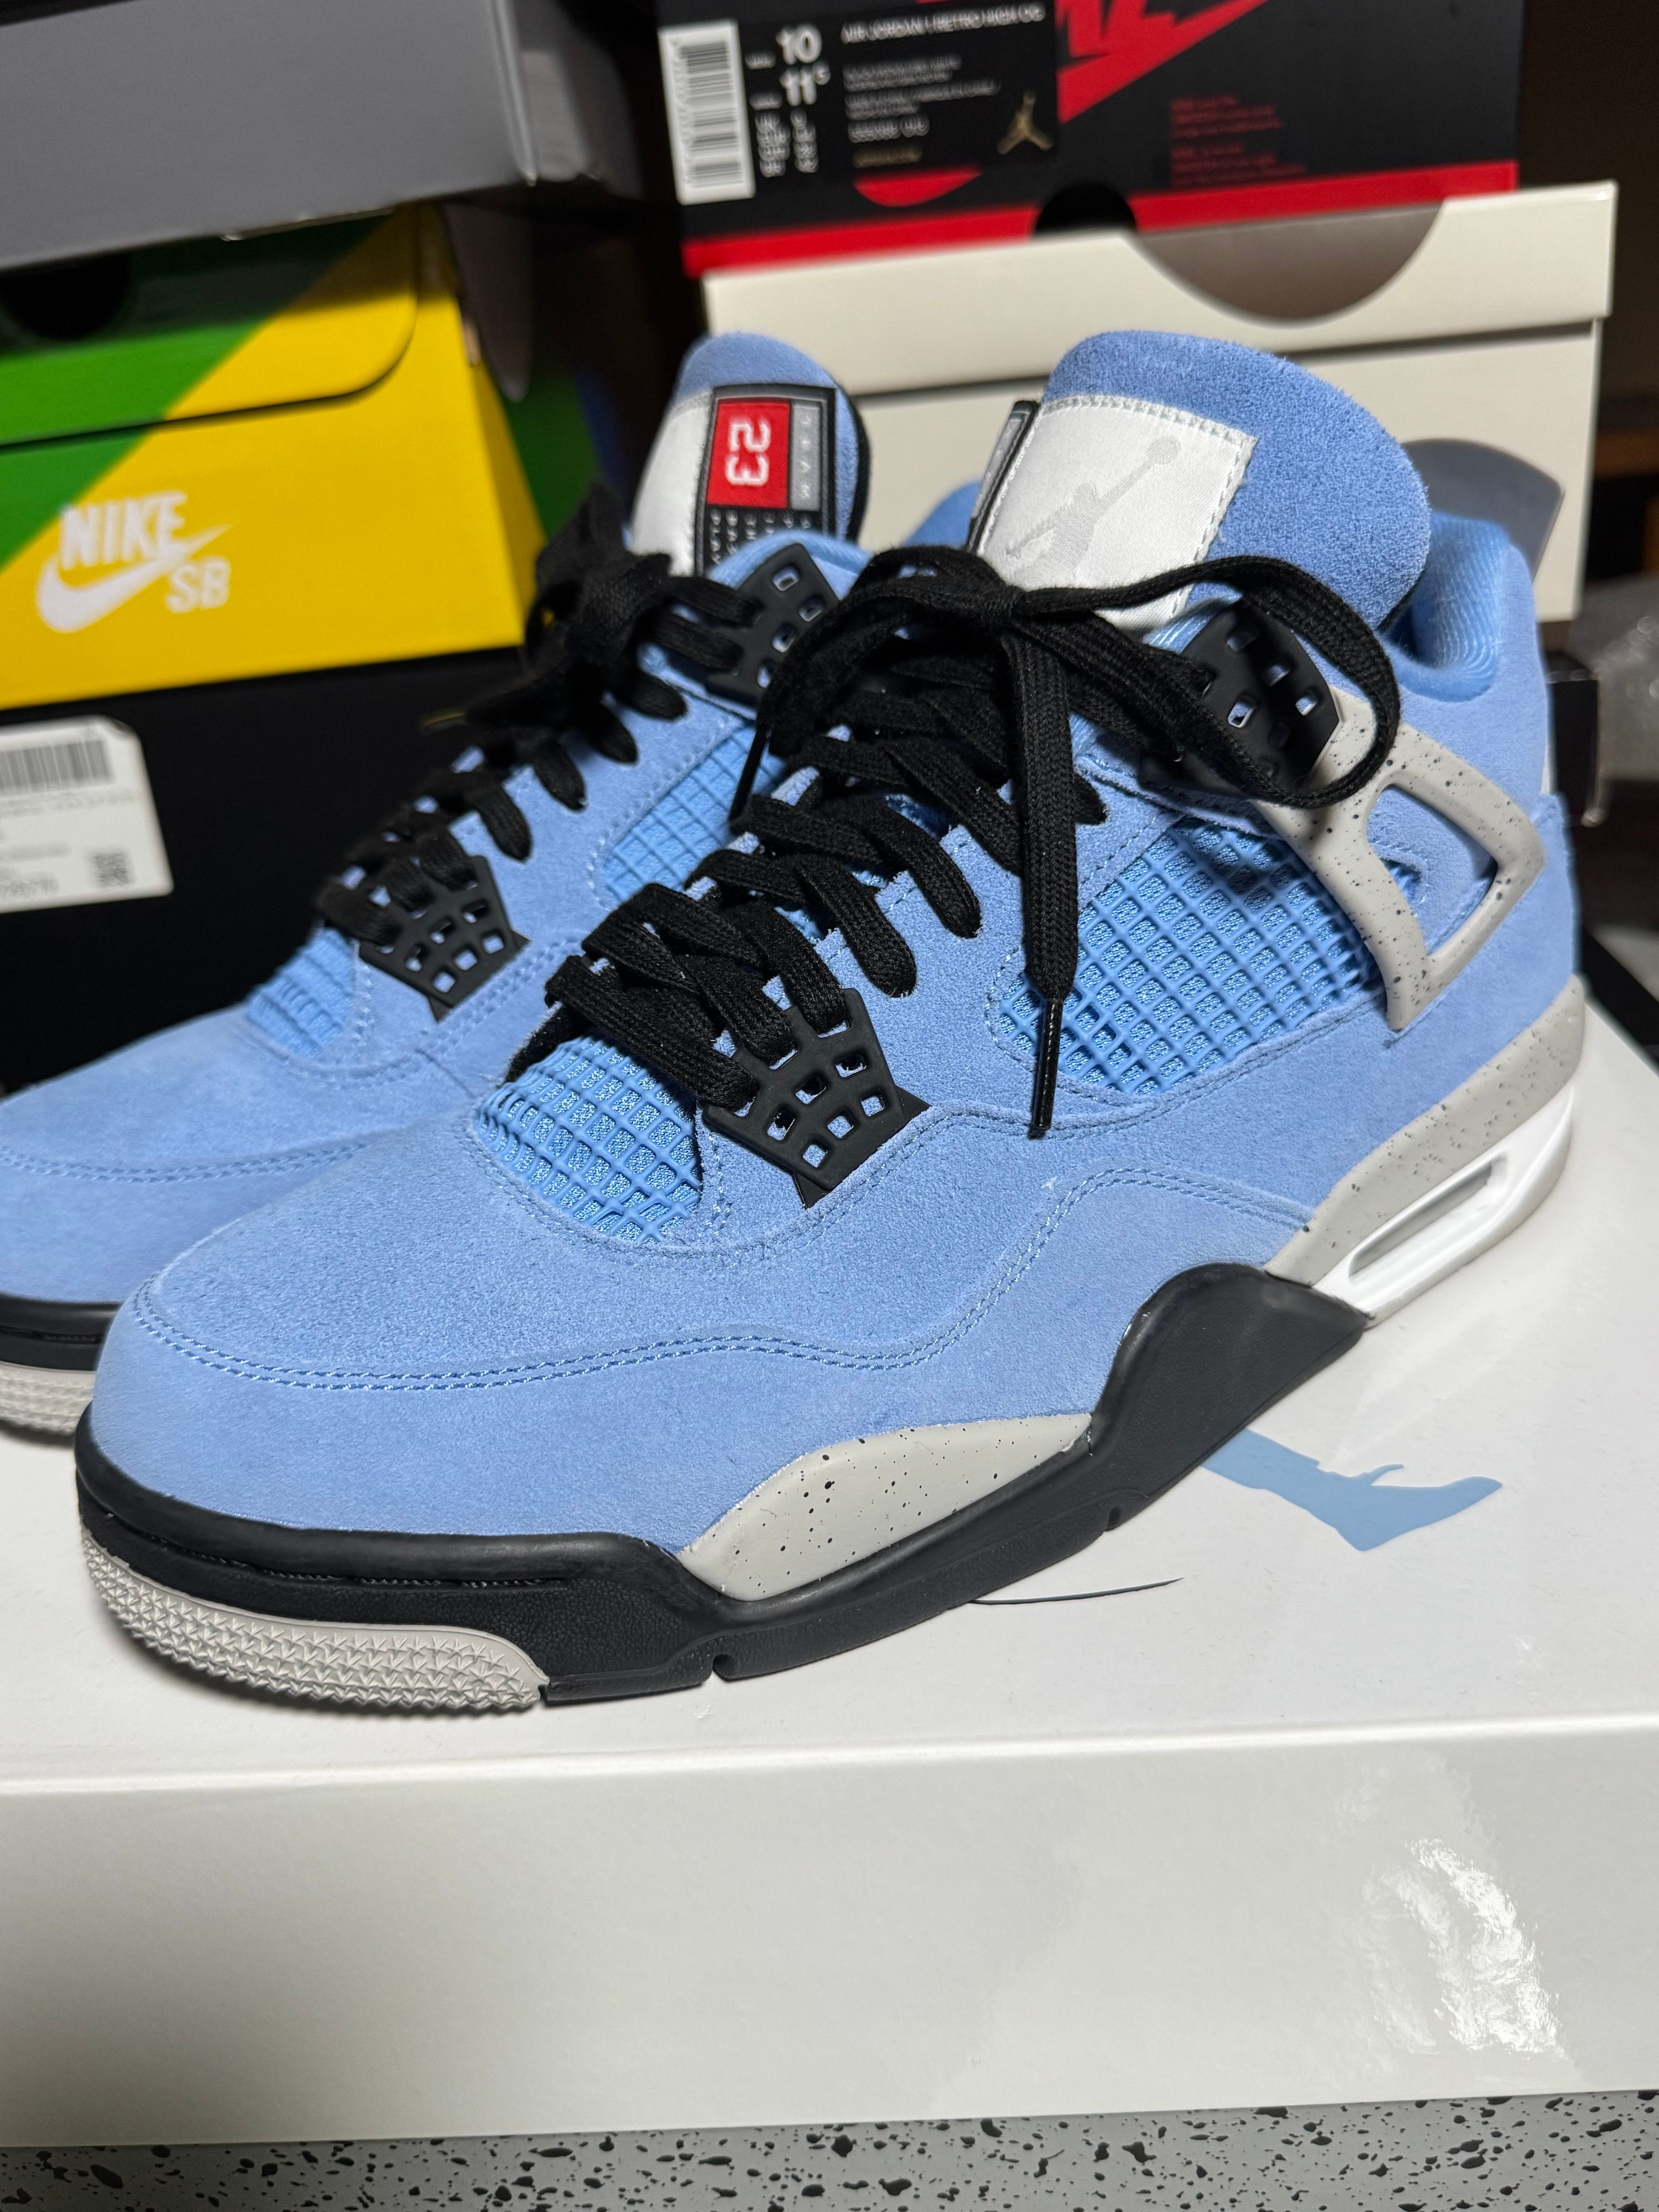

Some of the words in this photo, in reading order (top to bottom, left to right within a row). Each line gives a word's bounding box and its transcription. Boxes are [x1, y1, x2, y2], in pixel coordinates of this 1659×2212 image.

[776, 24, 822, 65] 10
[725, 417, 772, 486] 23
[58, 489, 187, 572] NIKE
[164, 555, 232, 614] SB
